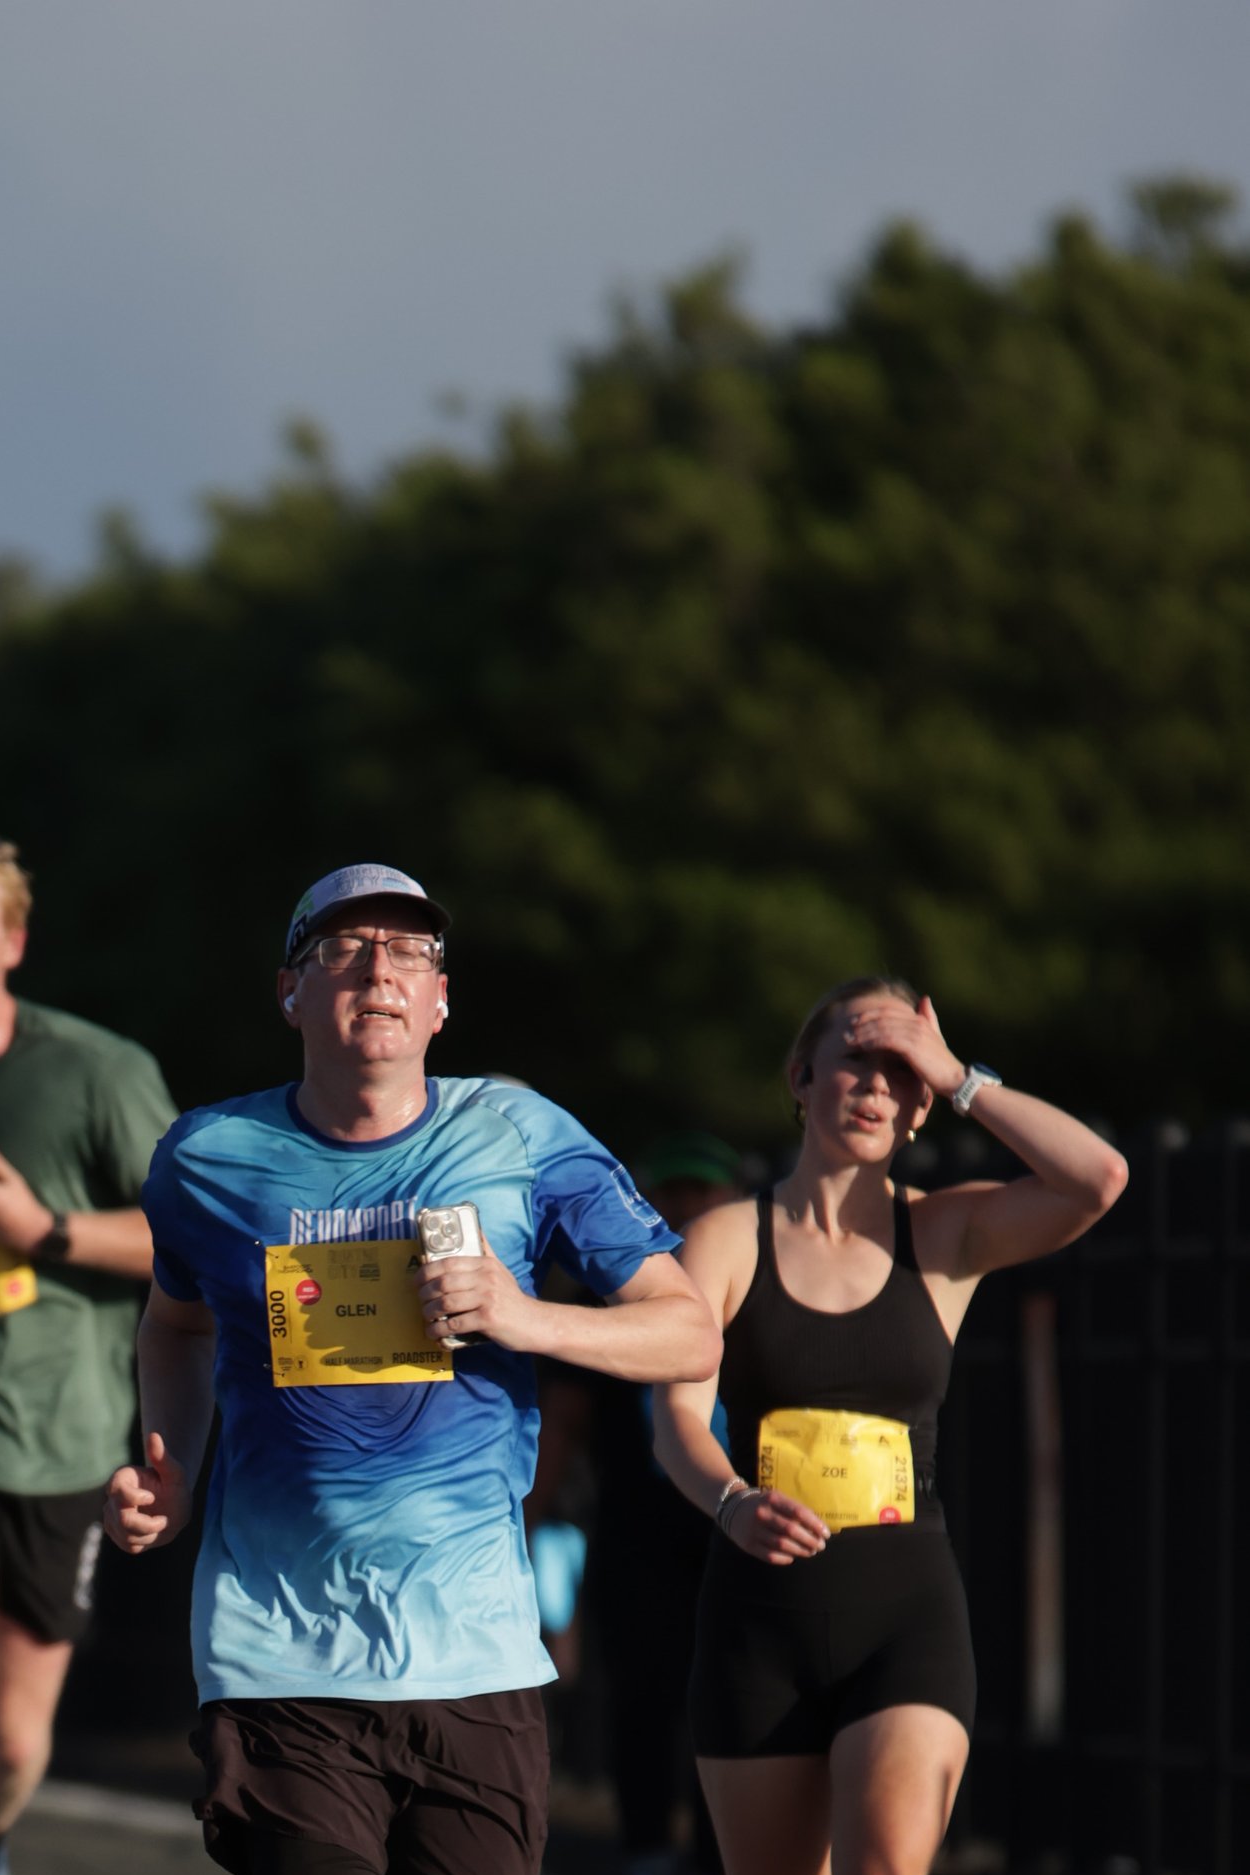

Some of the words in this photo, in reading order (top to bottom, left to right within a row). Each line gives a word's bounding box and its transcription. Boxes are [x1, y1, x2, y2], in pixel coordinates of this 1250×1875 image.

[269, 1290, 287, 1338] 3000
[335, 1304, 377, 1317] GLEN
[344, 1356, 383, 1365] MARATHON
[392, 1351, 443, 1364] ROADSTER
[821, 1466, 848, 1479] ZOE
[894, 1456, 909, 1502] 21374
